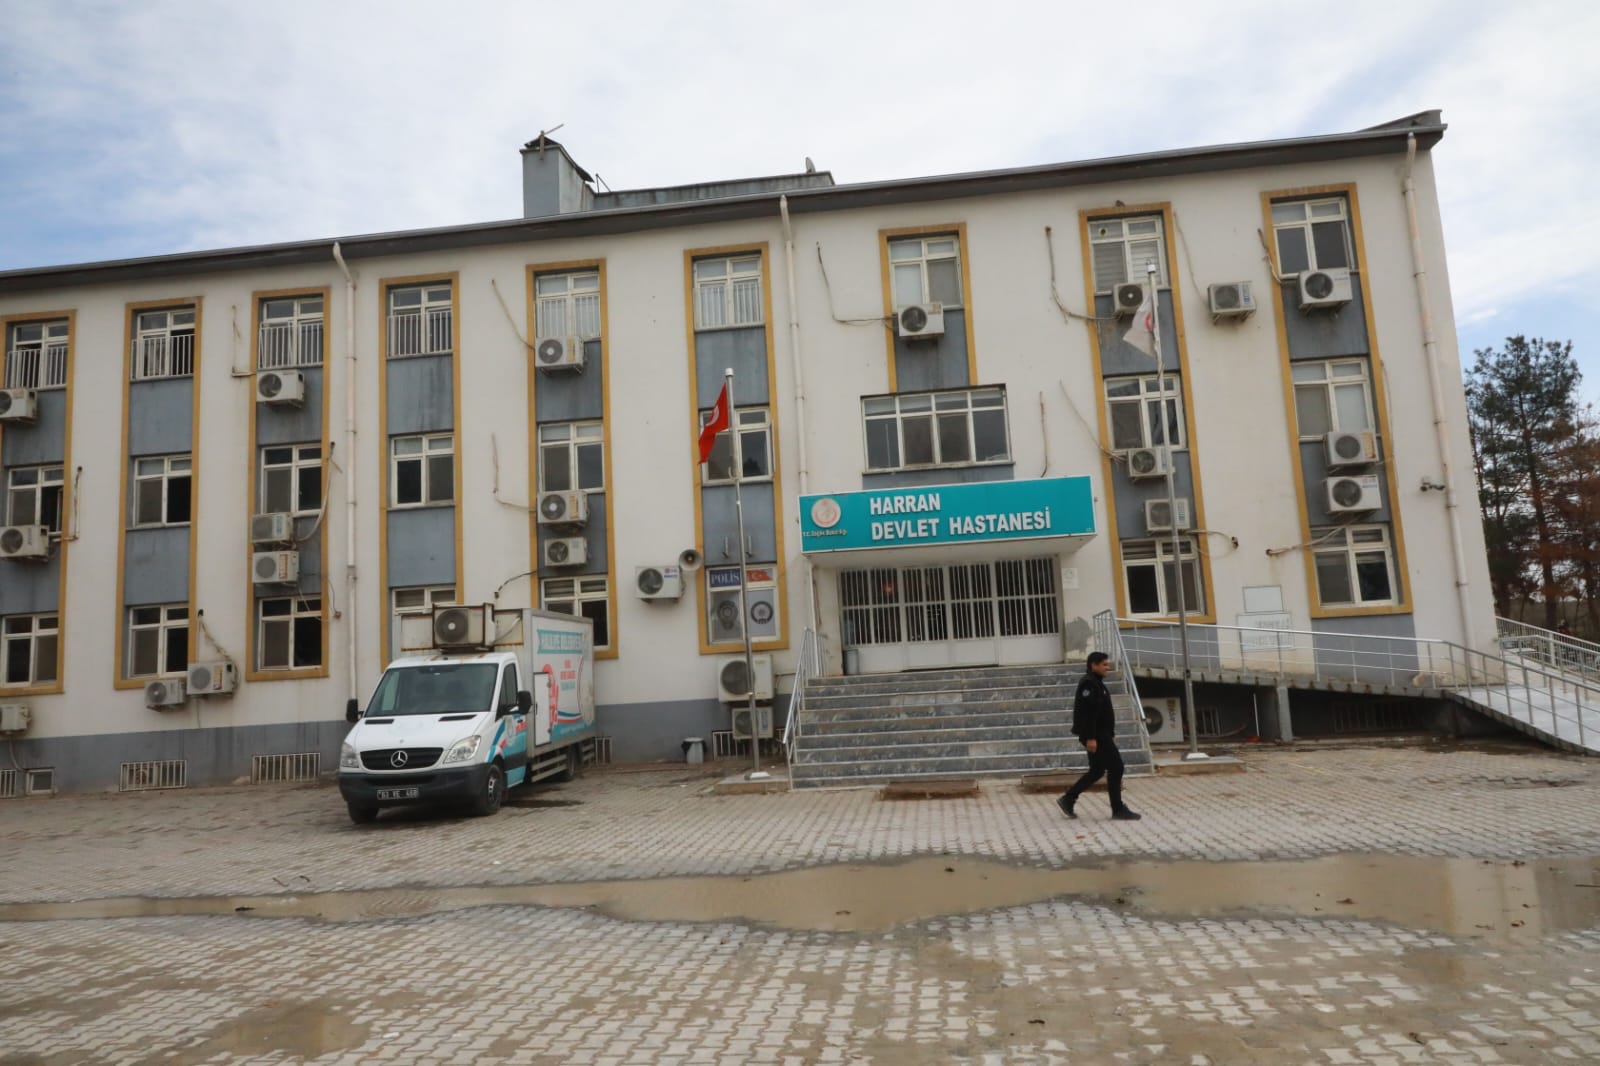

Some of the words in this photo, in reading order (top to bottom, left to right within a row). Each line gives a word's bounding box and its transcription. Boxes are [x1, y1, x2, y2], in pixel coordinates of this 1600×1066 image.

[870, 493, 941, 515] HARRAN
[871, 518, 940, 541] DEVLET
[949, 506, 1051, 536] HASTANESİ
[711, 570, 740, 585] POLİS
